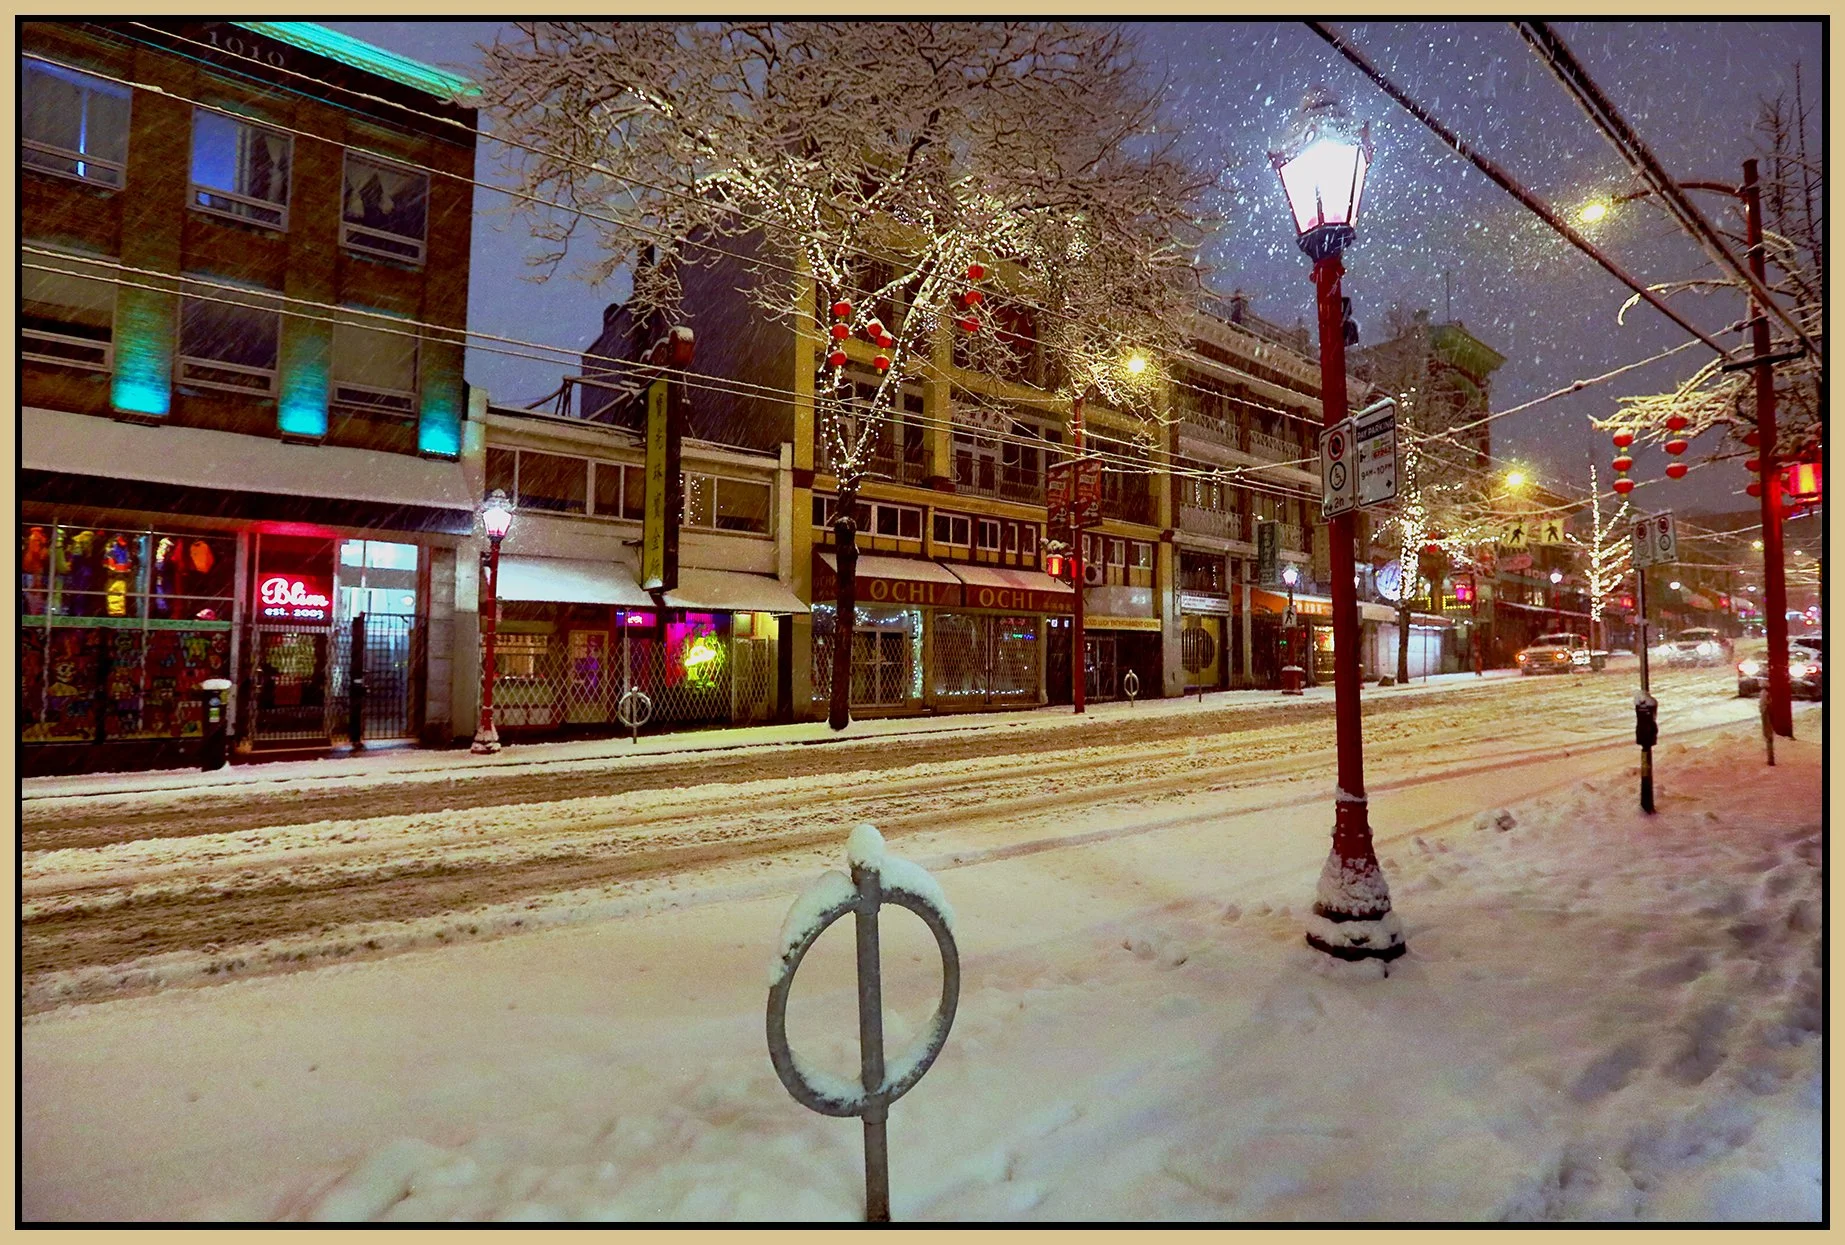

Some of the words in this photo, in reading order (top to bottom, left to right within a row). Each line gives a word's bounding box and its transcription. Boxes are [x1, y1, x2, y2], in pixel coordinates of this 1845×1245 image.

[209, 31, 285, 67] 1010
[1357, 429, 1367, 440] PAY
[1367, 418, 1394, 436] PARKING
[261, 577, 329, 607] Blim
[870, 580, 934, 603] OCHI
[979, 588, 1033, 610] OCHI
[264, 607, 290, 616] est.
[293, 608, 324, 620] 2003
